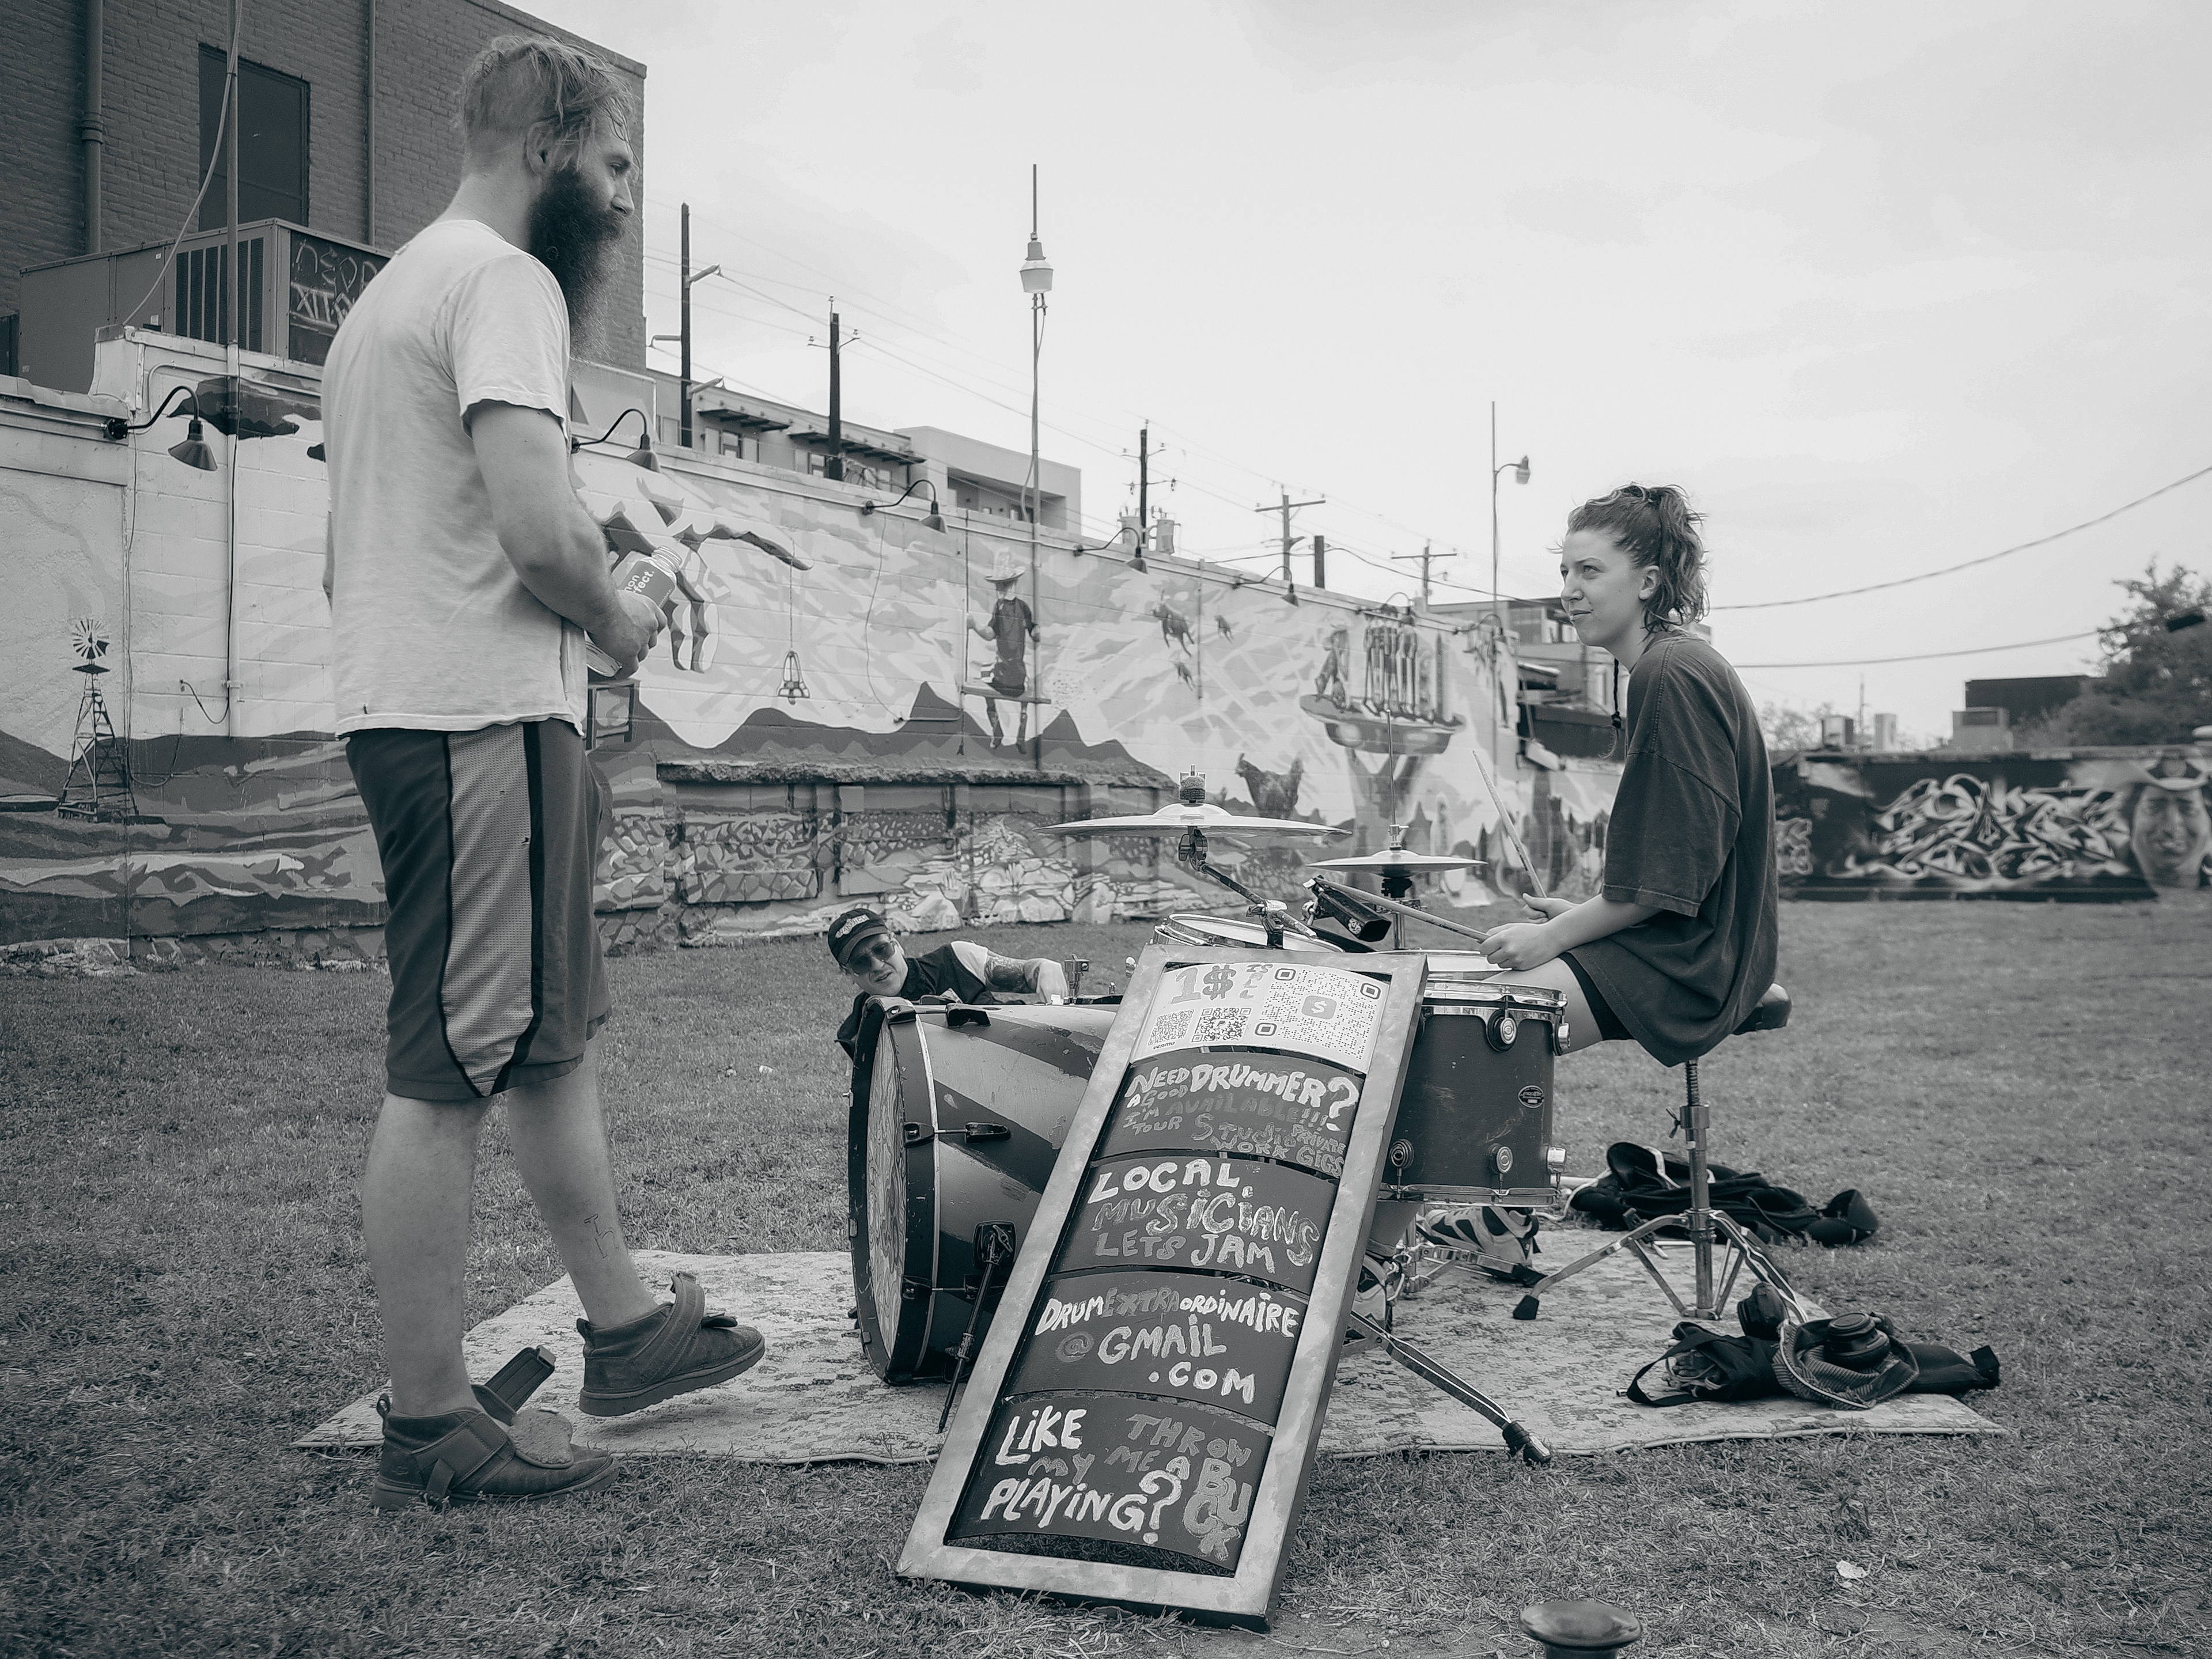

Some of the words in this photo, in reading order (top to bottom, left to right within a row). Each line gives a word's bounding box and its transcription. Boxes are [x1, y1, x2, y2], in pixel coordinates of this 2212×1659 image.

[1124, 1066, 1190, 1098] NEED
[1190, 1064, 1359, 1131] DRUMMER?
[1127, 1093, 1141, 1108] A
[1140, 1085, 1188, 1108] GOOD
[1132, 1116, 1183, 1136] TOUR
[1210, 1134, 1290, 1160] WORK
[1088, 1158, 1241, 1205] LOCAL
[1096, 1228, 1187, 1260] LETS
[1190, 1233, 1276, 1274] JAM
[1147, 1361, 1256, 1404] .COM
[1126, 1412, 1252, 1467] THROW
[1027, 1452, 1096, 1486] MY
[1103, 1445, 1162, 1473] ME
[1166, 1455, 1191, 1480] A
